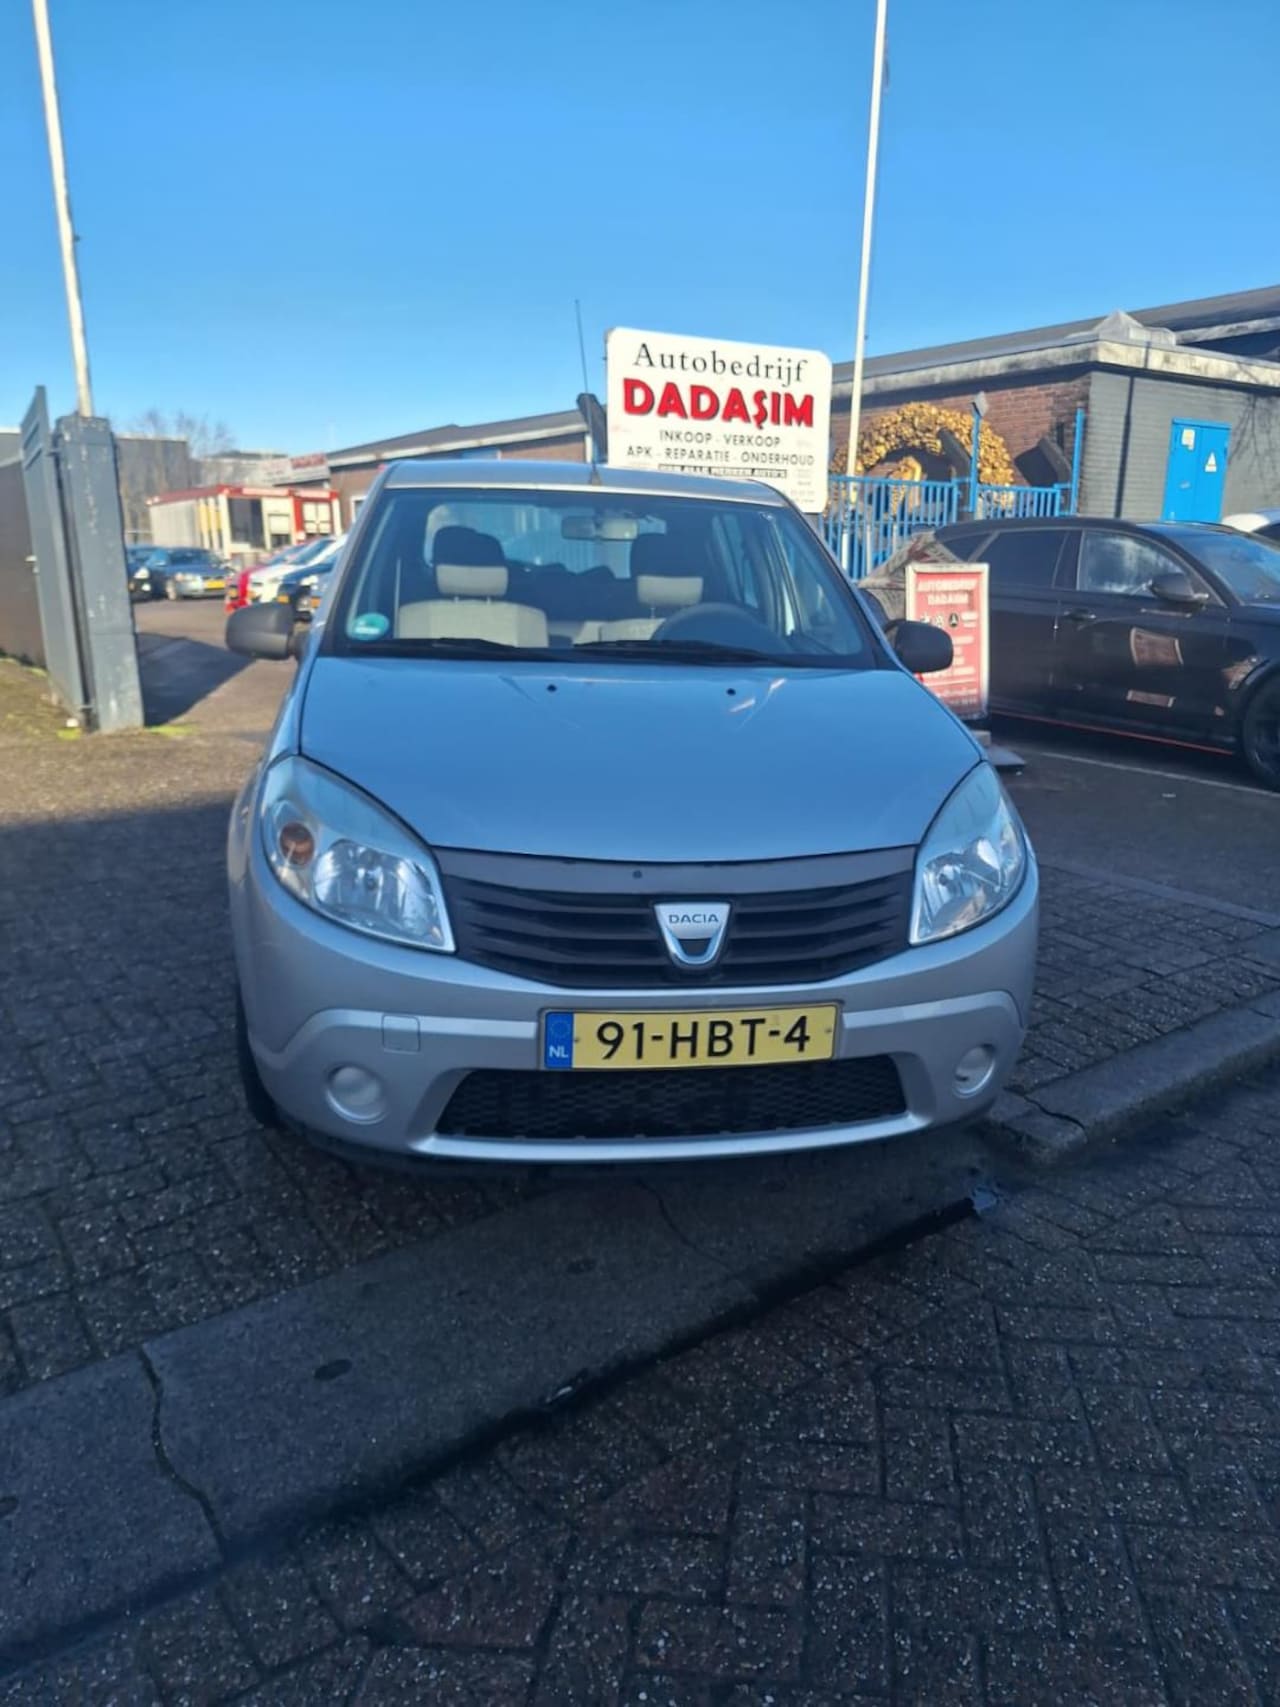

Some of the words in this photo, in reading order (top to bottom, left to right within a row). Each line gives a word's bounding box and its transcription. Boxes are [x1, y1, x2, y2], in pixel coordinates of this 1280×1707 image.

[633, 343, 808, 387] Autobedrijf
[623, 378, 814, 429] DADAŞIM
[659, 429, 713, 444] INKOOP
[723, 434, 781, 447] VERKOOP
[626, 445, 653, 457] APK
[665, 447, 730, 463] REPARATIE
[741, 452, 815, 466] ONDERHOUD
[668, 913, 719, 925] DACIA
[549, 1045, 569, 1059] NL
[597, 1015, 811, 1060] 91-HBT-4
